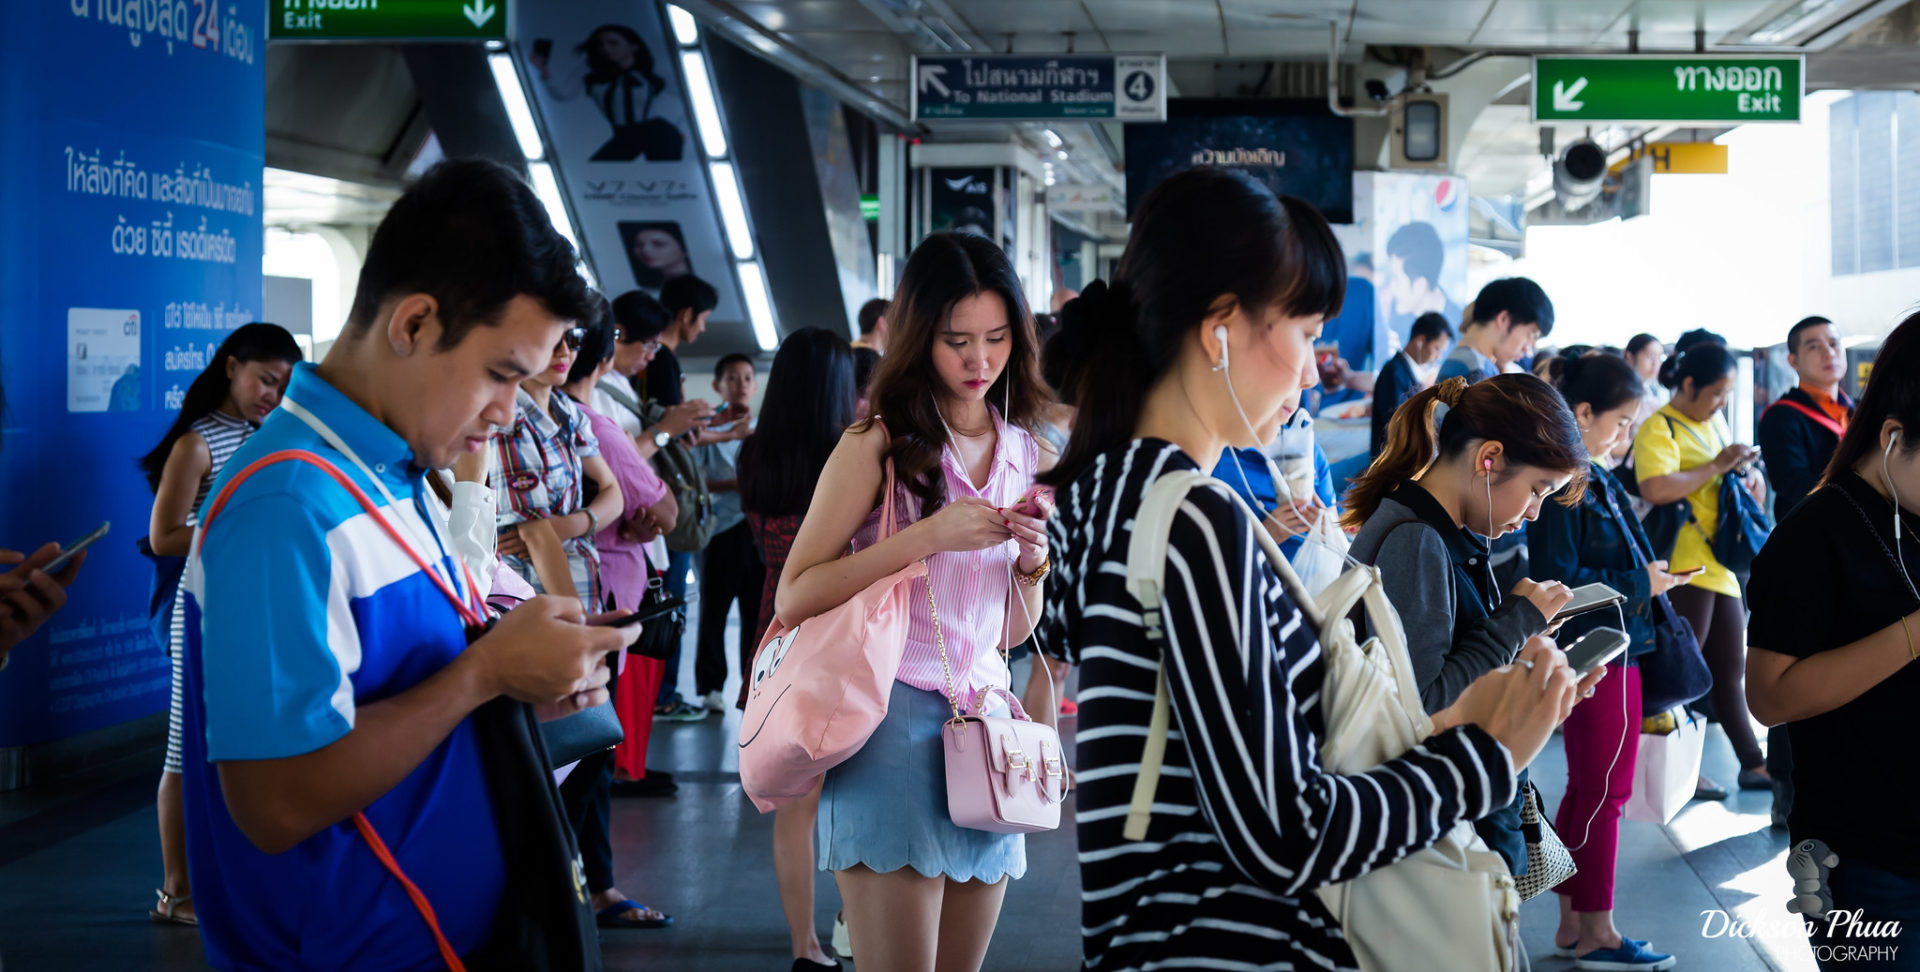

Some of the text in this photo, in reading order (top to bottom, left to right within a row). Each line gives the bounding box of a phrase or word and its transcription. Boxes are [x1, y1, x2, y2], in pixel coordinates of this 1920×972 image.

[193, 0, 219, 53] 24
[284, 11, 322, 29] Exit
[962, 59, 1099, 86] ไปสนามกีฬาฯ
[1674, 66, 1782, 91] ทางออก
[953, 89, 1114, 103] To National Stadium
[1128, 73, 1149, 98] 4
[1737, 92, 1781, 113] Exit
[65, 146, 147, 199] ให้สิ่งที่คิด
[112, 214, 147, 255] ด้วย
